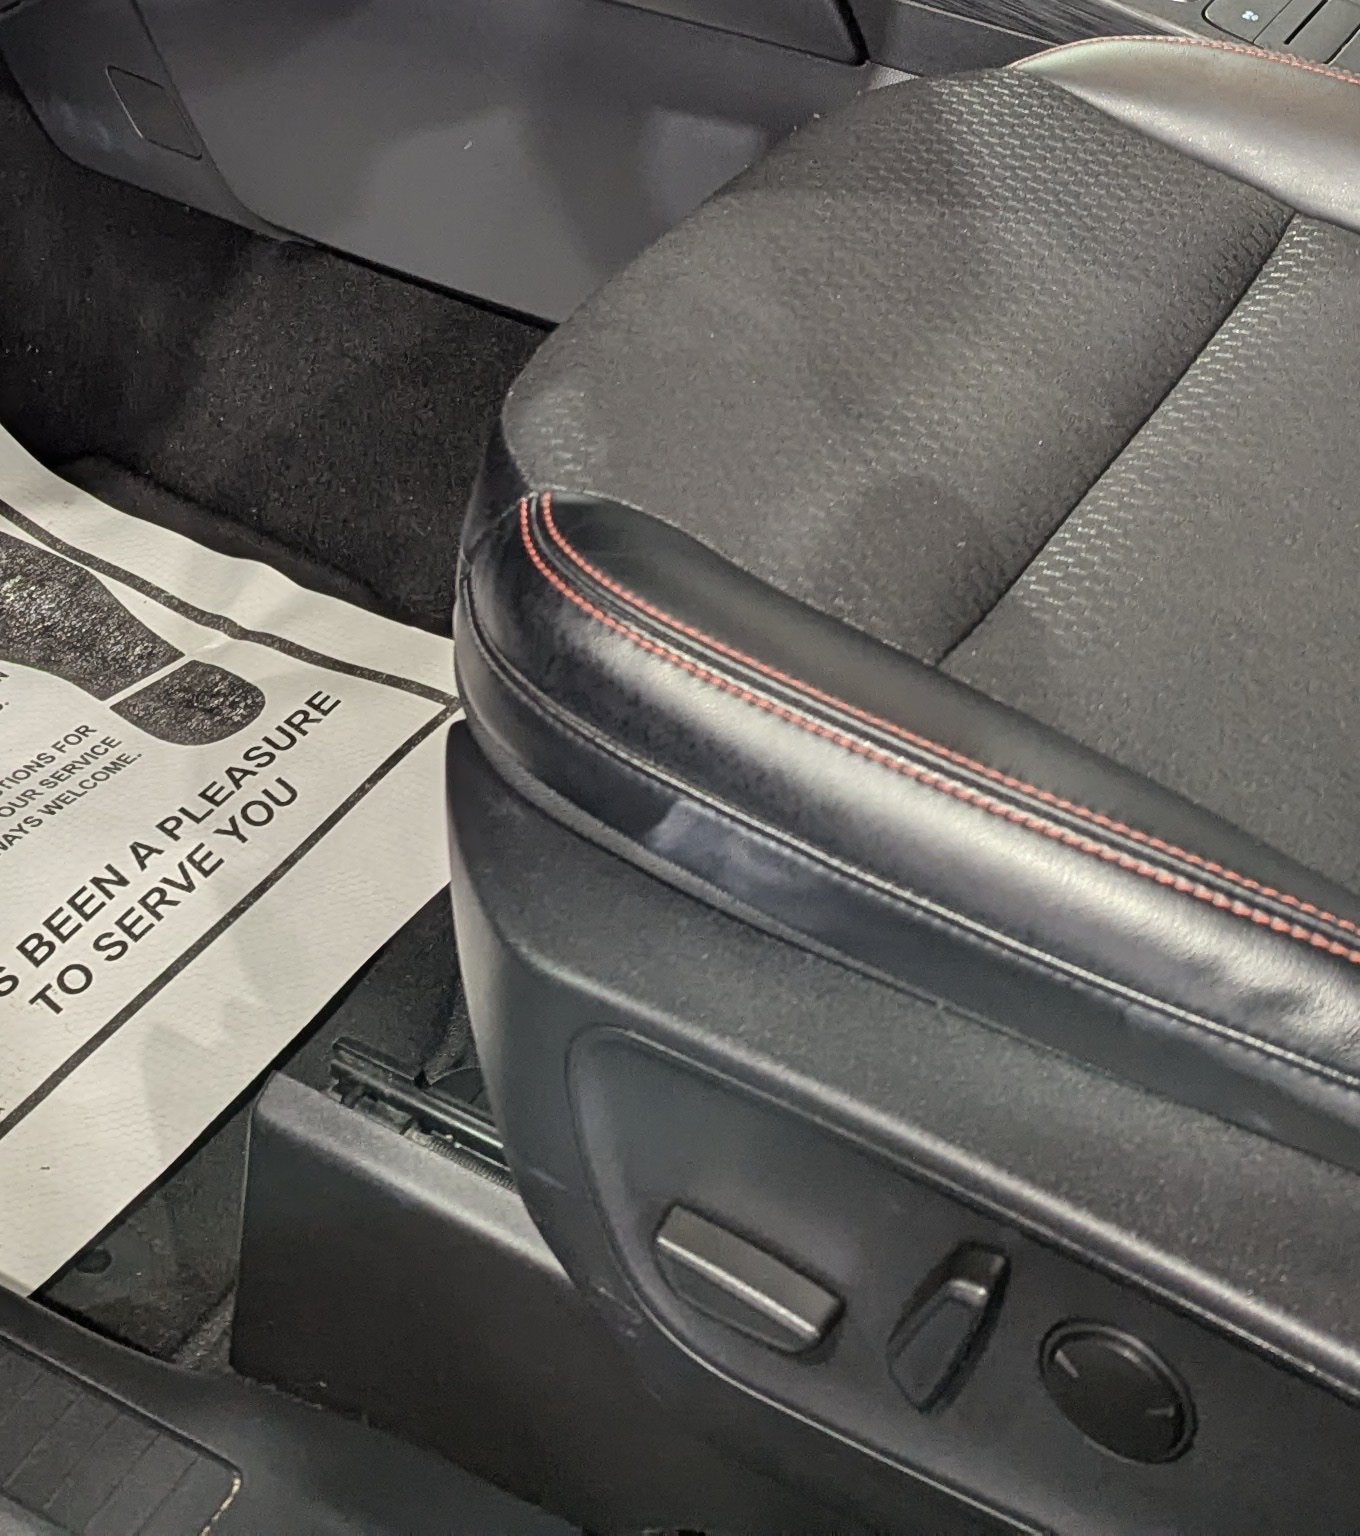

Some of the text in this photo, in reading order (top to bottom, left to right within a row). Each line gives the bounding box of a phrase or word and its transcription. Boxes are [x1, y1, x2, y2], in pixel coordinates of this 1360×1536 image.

[38, 736, 123, 790] SERVICE
[51, 724, 98, 753] FOR
[38, 751, 143, 816] WELCOME.
[16, 862, 132, 969] BEEN
[127, 840, 165, 872] A
[154, 689, 343, 843] PLEASURE
[28, 776, 299, 1017] TO SERVE YOU
